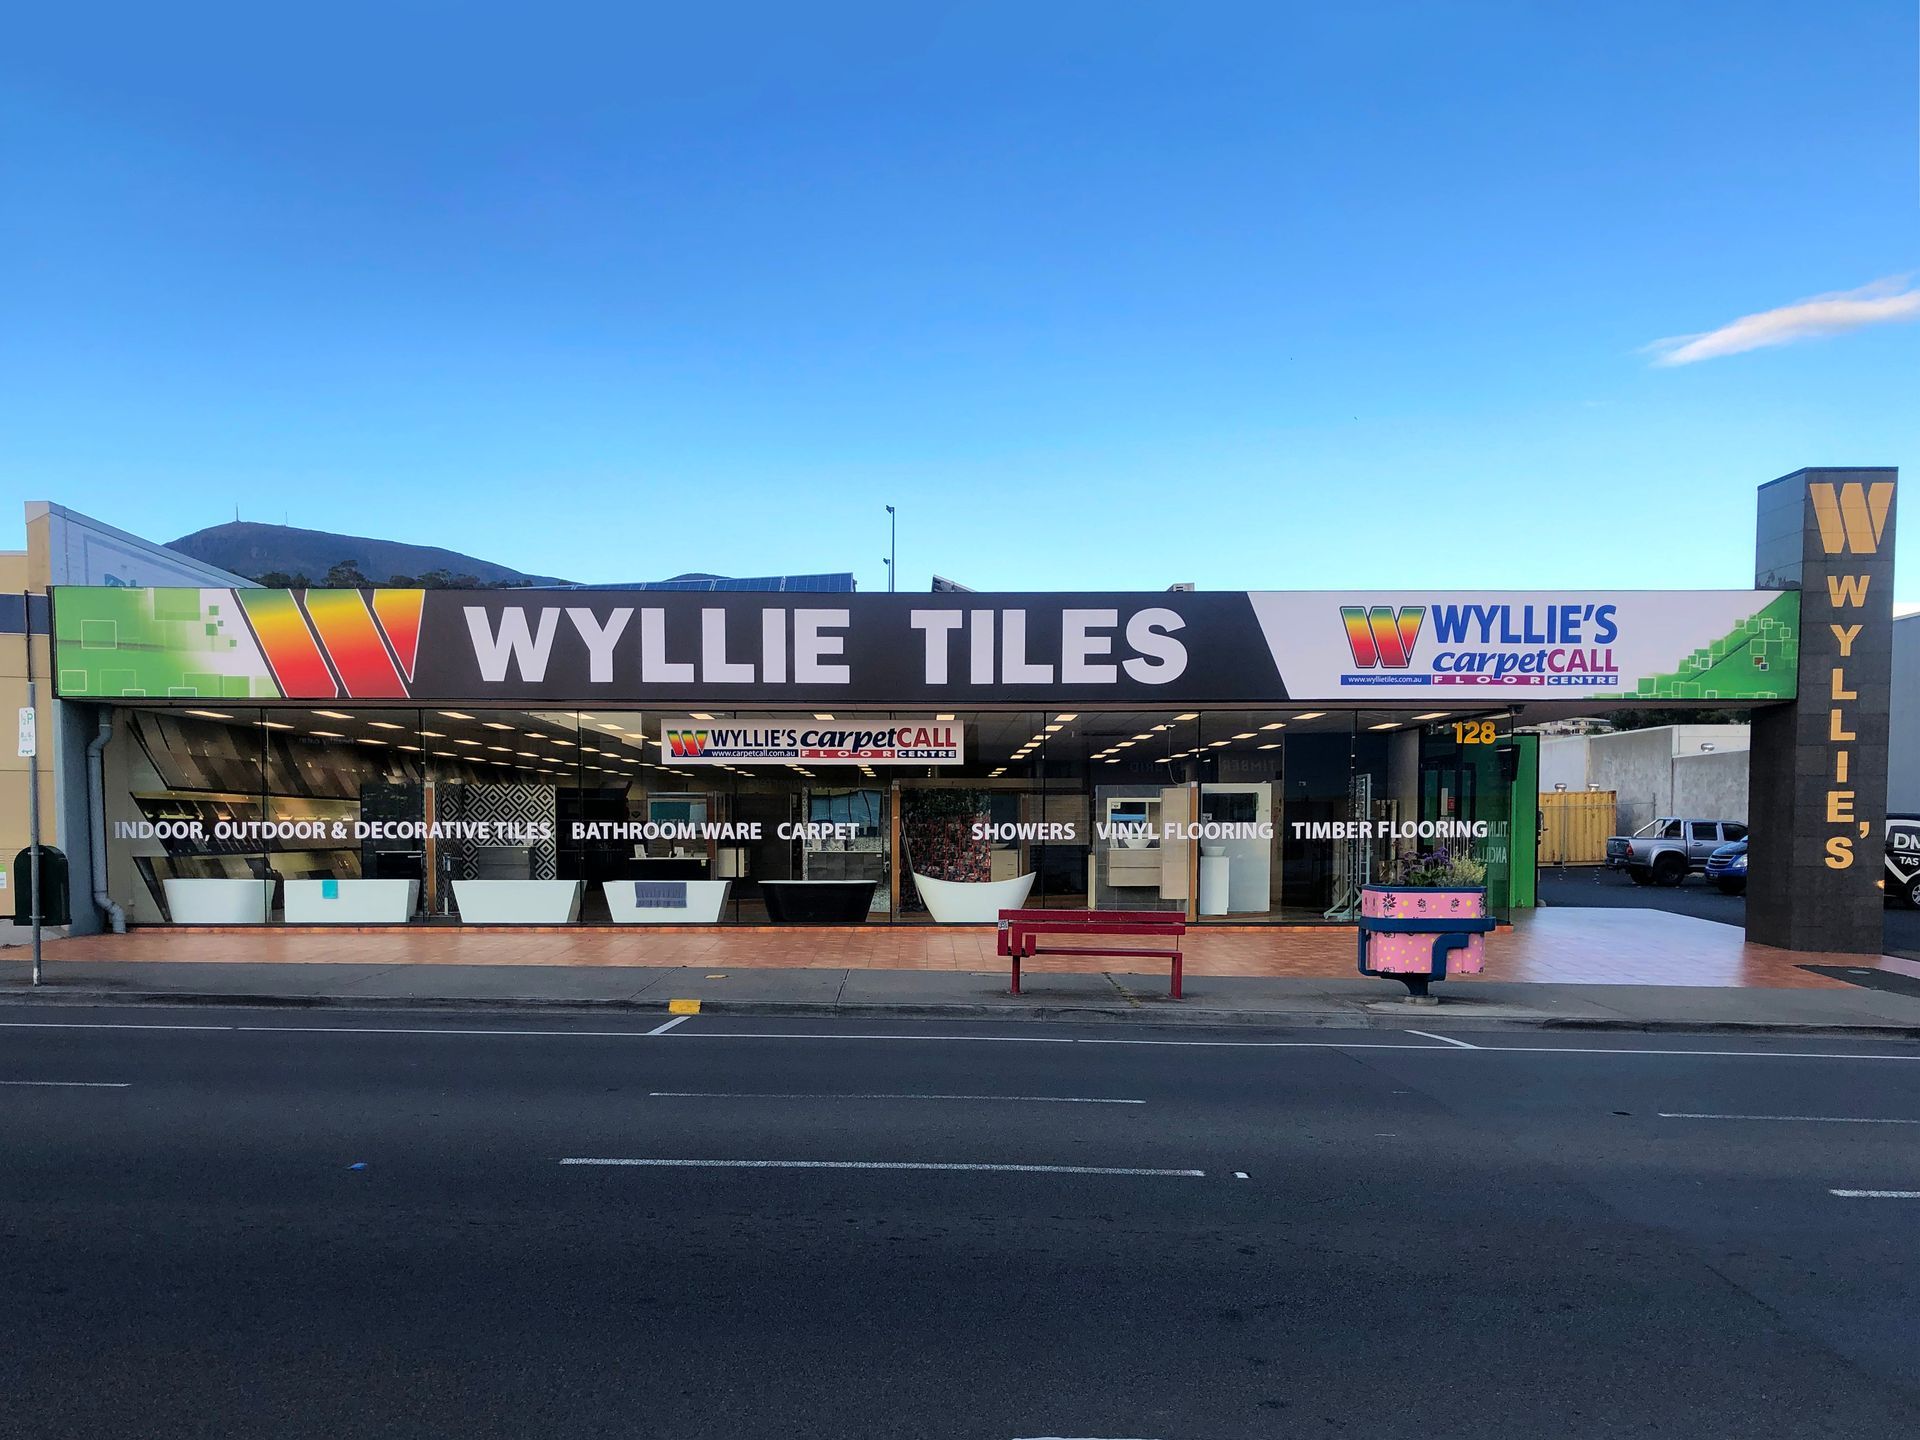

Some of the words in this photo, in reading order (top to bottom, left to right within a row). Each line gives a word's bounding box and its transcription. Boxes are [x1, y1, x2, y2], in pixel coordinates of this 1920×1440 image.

[1431, 604, 1618, 644] WYLLIE'S
[463, 606, 851, 685] WYLLIE
[911, 607, 1188, 685] TILES
[1432, 648, 1618, 680] carpetCALL
[1348, 675, 1422, 684] www.wyllietiles.com.au
[1434, 675, 1542, 684] FLOOR
[1548, 676, 1618, 684] CENTRE
[1824, 575, 1870, 869] WYLLIE'S
[711, 729, 797, 747] WYLLIE'S
[800, 727, 957, 754] carpetCALL
[1455, 721, 1496, 744] 128
[711, 750, 796, 758] www.carpetcall.com.au
[802, 750, 892, 758] FLOOR
[114, 821, 210, 843] INDOOR,
[214, 821, 326, 840] OUTDOOR
[331, 821, 348, 840] &
[355, 821, 490, 840] DECORATIVE
[494, 822, 551, 840] TILES
[572, 822, 697, 840] BATHROOM
[699, 822, 762, 840] WARE
[777, 822, 860, 840] CARPET
[971, 822, 1076, 840] SHOWERS
[1096, 822, 1161, 840] VINYL
[1164, 822, 1274, 840] FLOORING
[1291, 821, 1373, 840] TIMBER
[1378, 820, 1488, 839] FLOORING
